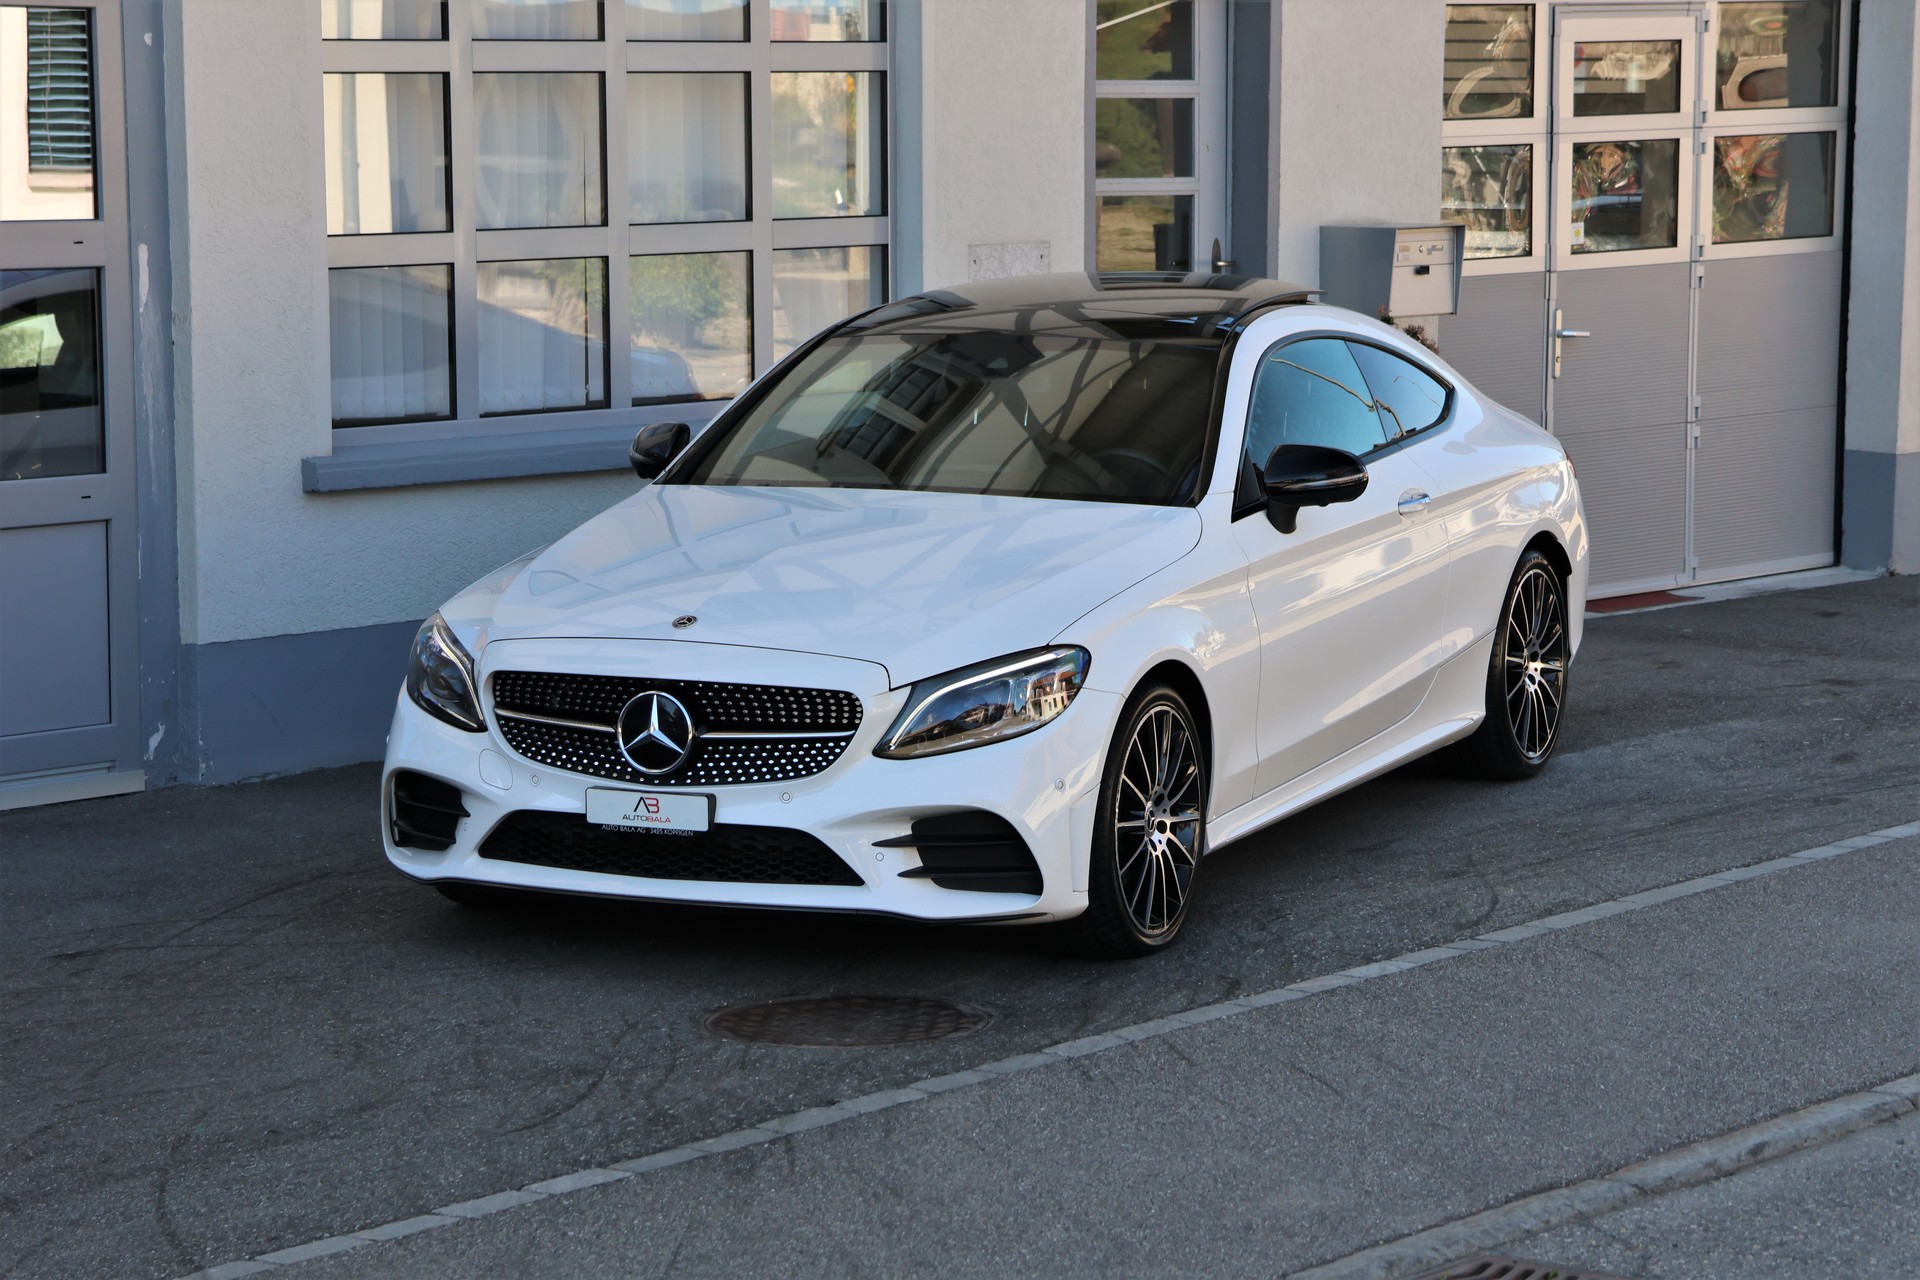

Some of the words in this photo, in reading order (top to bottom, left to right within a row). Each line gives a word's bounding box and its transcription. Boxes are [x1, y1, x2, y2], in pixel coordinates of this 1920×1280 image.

[622, 814, 671, 824] AUTOBALA
[601, 824, 619, 832] AUTO
[620, 825, 636, 833] BALA
